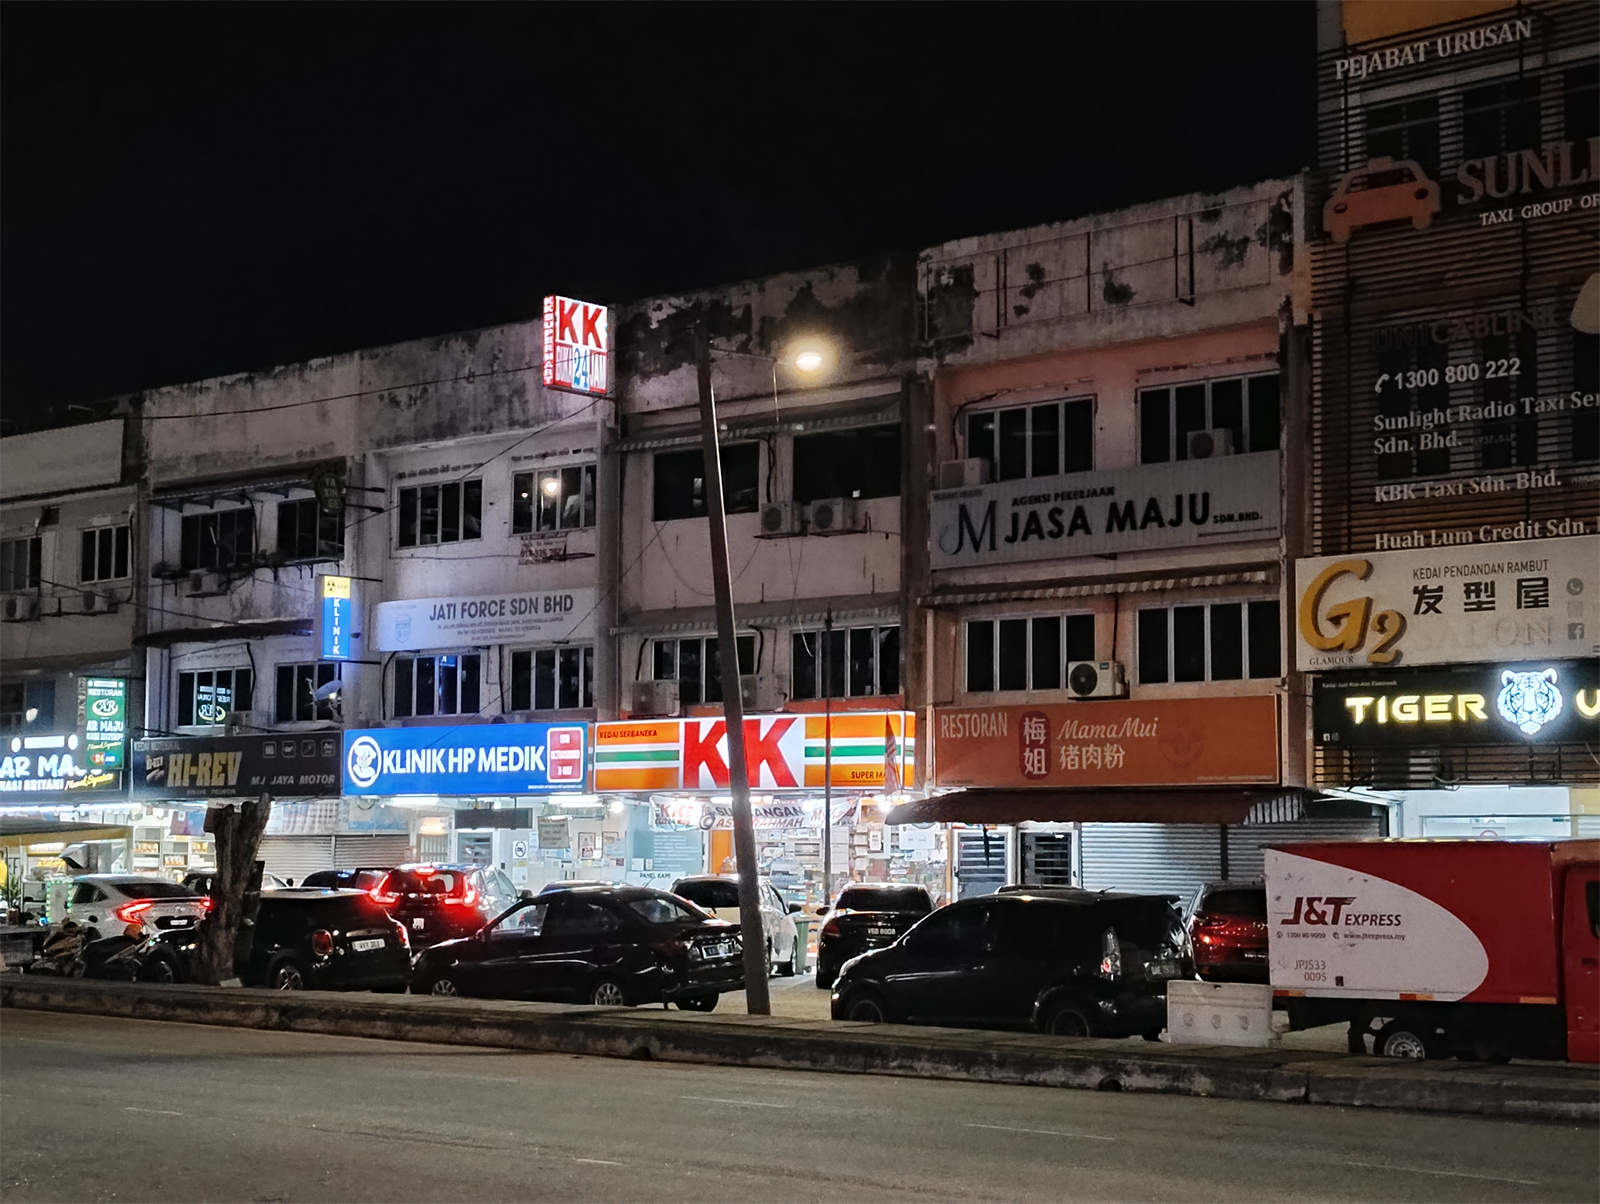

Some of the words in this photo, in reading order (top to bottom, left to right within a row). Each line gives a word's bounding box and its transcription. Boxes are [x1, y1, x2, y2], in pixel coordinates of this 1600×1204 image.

[1335, 41, 1430, 80] PEJABAT
[1437, 17, 1533, 57] URUSAN
[1479, 208, 1514, 226] TAXI
[1521, 198, 1573, 219] GROUP
[559, 299, 603, 349] KK
[574, 347, 588, 388] 24
[1394, 369, 1439, 390] 1300
[1445, 363, 1480, 384] 800
[1485, 357, 1521, 379] 222
[1374, 407, 1453, 436] Sunlight
[1458, 400, 1516, 422] Radio
[1520, 395, 1565, 414] Taxi
[1374, 436, 1414, 455] Sdn.
[1419, 430, 1463, 450] Bhd.
[1012, 489, 1053, 507] AGENSI
[1054, 486, 1115, 502] PEKERJAAN
[1375, 485, 1416, 503] KBK
[1421, 480, 1464, 498] Taxi
[1469, 475, 1511, 495] Sdn.
[1516, 468, 1562, 490] Bhd.
[1004, 505, 1092, 544] JASA
[1105, 491, 1211, 533] MAJU
[1375, 530, 1425, 550] Huah
[1431, 528, 1474, 546] Lum
[1479, 521, 1542, 541] Credit
[1546, 516, 1591, 538] Sdn.
[1412, 567, 1441, 580] KEDAI
[1443, 565, 1504, 578] PENDANDAN
[1506, 559, 1549, 573] RAMBUT
[430, 603, 456, 621] JATI
[461, 599, 506, 619] FORCE
[510, 597, 540, 617] SDN
[543, 594, 574, 613] BHD
[1412, 576, 1550, 616] 发型屋
[333, 597, 341, 655] KLINIK
[1309, 655, 1355, 667] GLAMOUR
[88, 688, 123, 697] RESTORAN
[1345, 695, 1489, 725] TIGER
[86, 720, 98, 732] AR
[100, 720, 124, 732] MAJU
[620, 729, 658, 737] SERBANEKA
[941, 712, 1008, 739] RESTORAN
[382, 747, 446, 775] KLINIK
[449, 747, 476, 773] HP
[478, 745, 546, 773] MEDIK
[683, 717, 800, 789] KK
[1023, 716, 1048, 775] 梅姐
[1059, 743, 1126, 771] 猪肉粉
[0, 755, 30, 778] AR
[167, 751, 242, 787] HI-REV
[251, 776, 266, 785] MJ
[270, 775, 295, 785] JAYA
[300, 774, 336, 784] MOTOR
[851, 771, 874, 779] SUPER
[1280, 896, 1357, 926] J&T
[1345, 913, 1402, 926] EXPRESS
